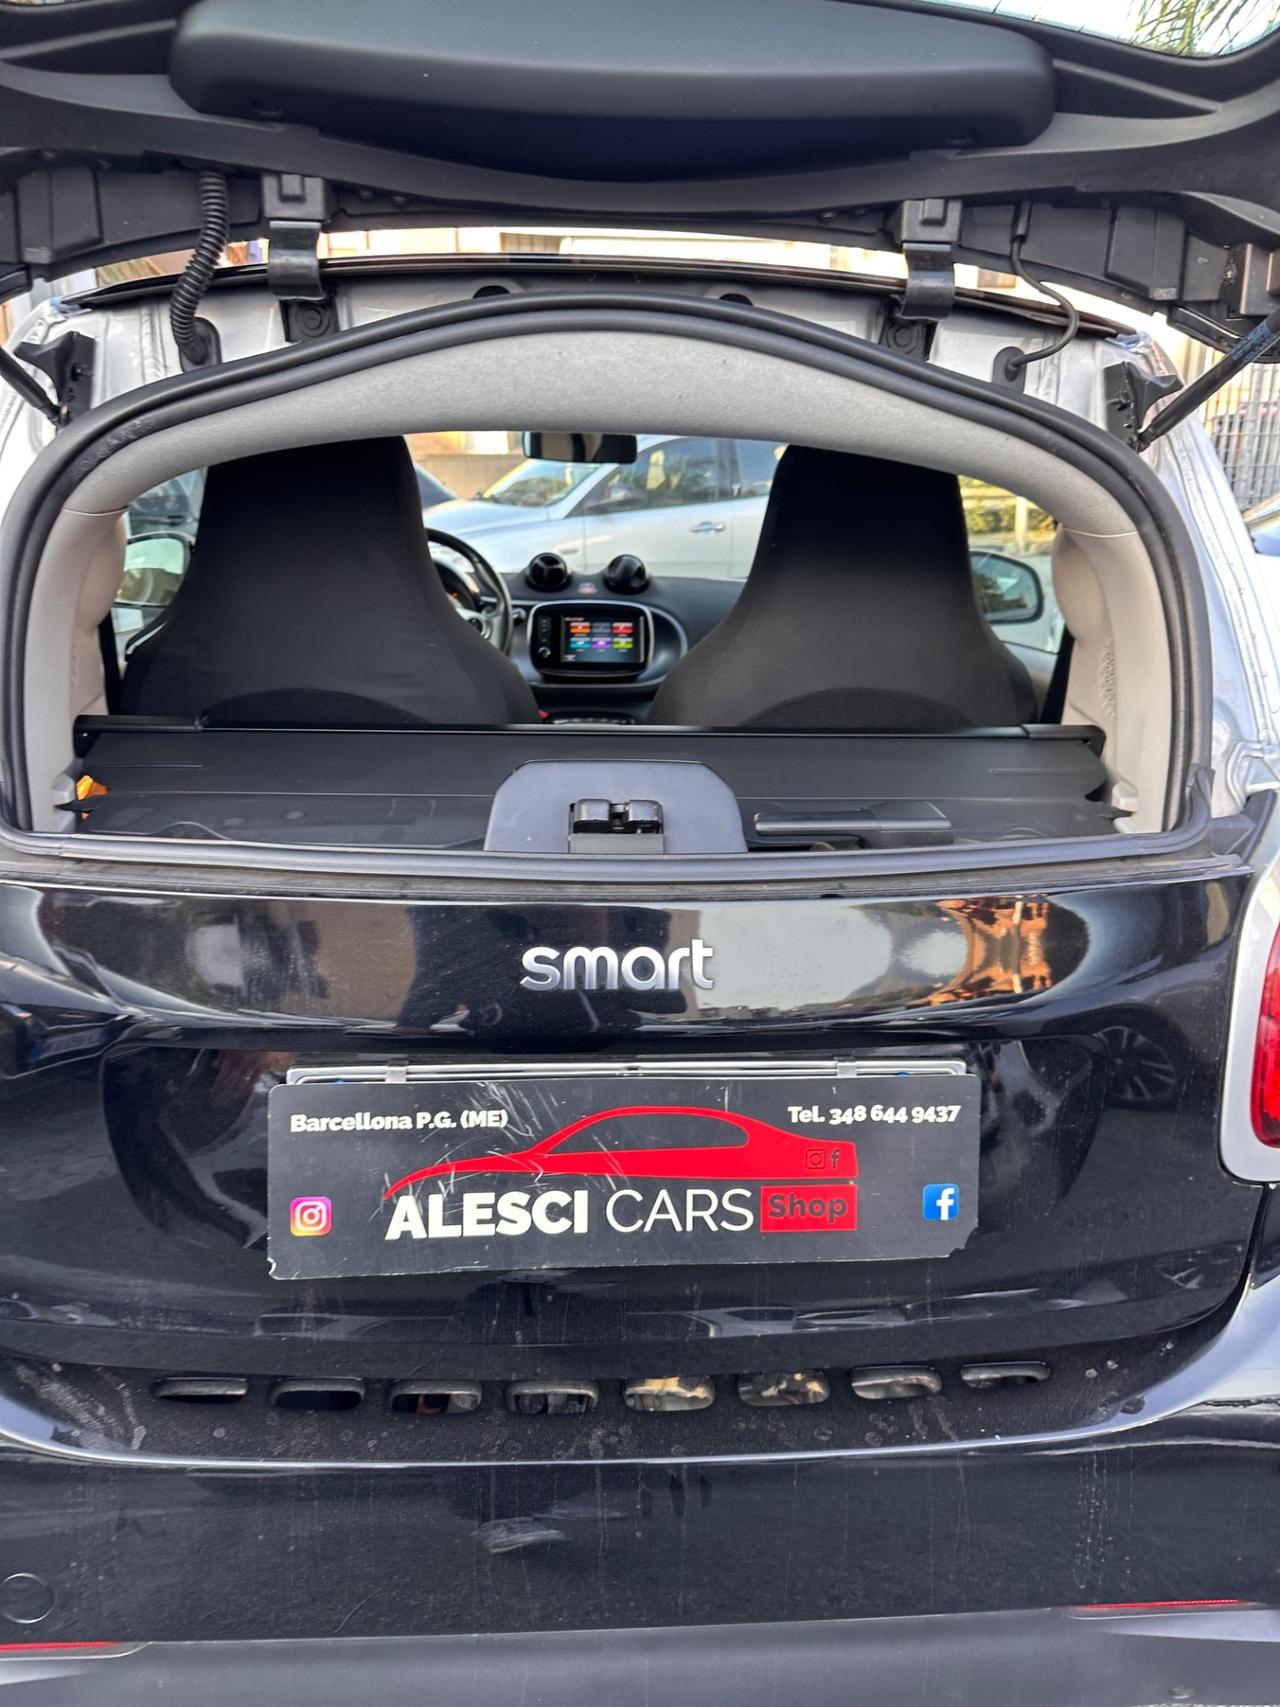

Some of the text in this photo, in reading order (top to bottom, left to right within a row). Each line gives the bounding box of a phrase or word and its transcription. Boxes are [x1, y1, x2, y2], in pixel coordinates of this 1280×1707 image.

[520, 939, 714, 991] smart
[290, 1109, 508, 1132] Barcellona P.G. (ME)
[787, 1104, 962, 1125] Tel. 348 644 9437
[385, 1188, 848, 1240] ALESCI CARS Shop
